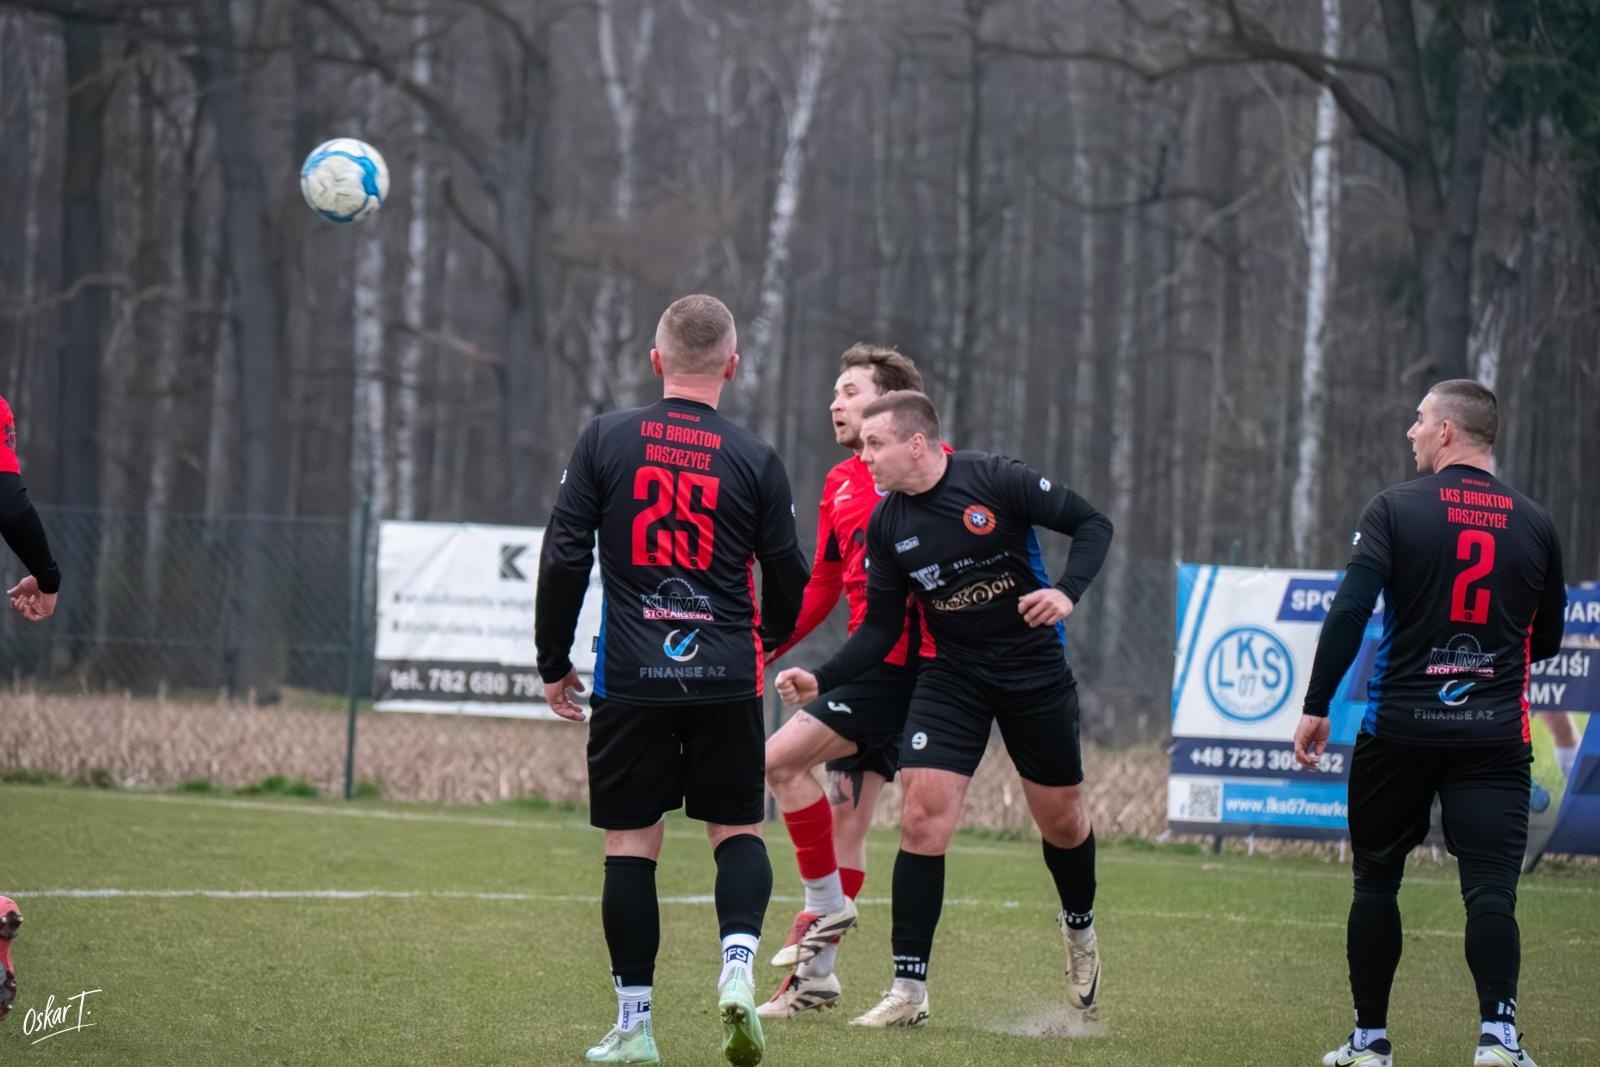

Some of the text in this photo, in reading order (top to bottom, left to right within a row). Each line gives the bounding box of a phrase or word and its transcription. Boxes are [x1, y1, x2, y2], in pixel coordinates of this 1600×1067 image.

[640, 421, 722, 450] LKS BRAXTON
[645, 443, 712, 470] RASZCZYCE
[1440, 487, 1513, 510] LKS BRAXTON
[632, 466, 720, 571] 25
[1447, 507, 1508, 529] RASZCZYCE
[1451, 529, 1496, 625] 2
[640, 666, 726, 678] FINANSE AZ
[1218, 635, 1281, 689] LKS
[390, 667, 425, 691] tel.
[1524, 682, 1567, 705] MY
[1414, 708, 1494, 720] FINANSE AZ
[1190, 746, 1224, 767] +48
[1227, 747, 1265, 770] 723
